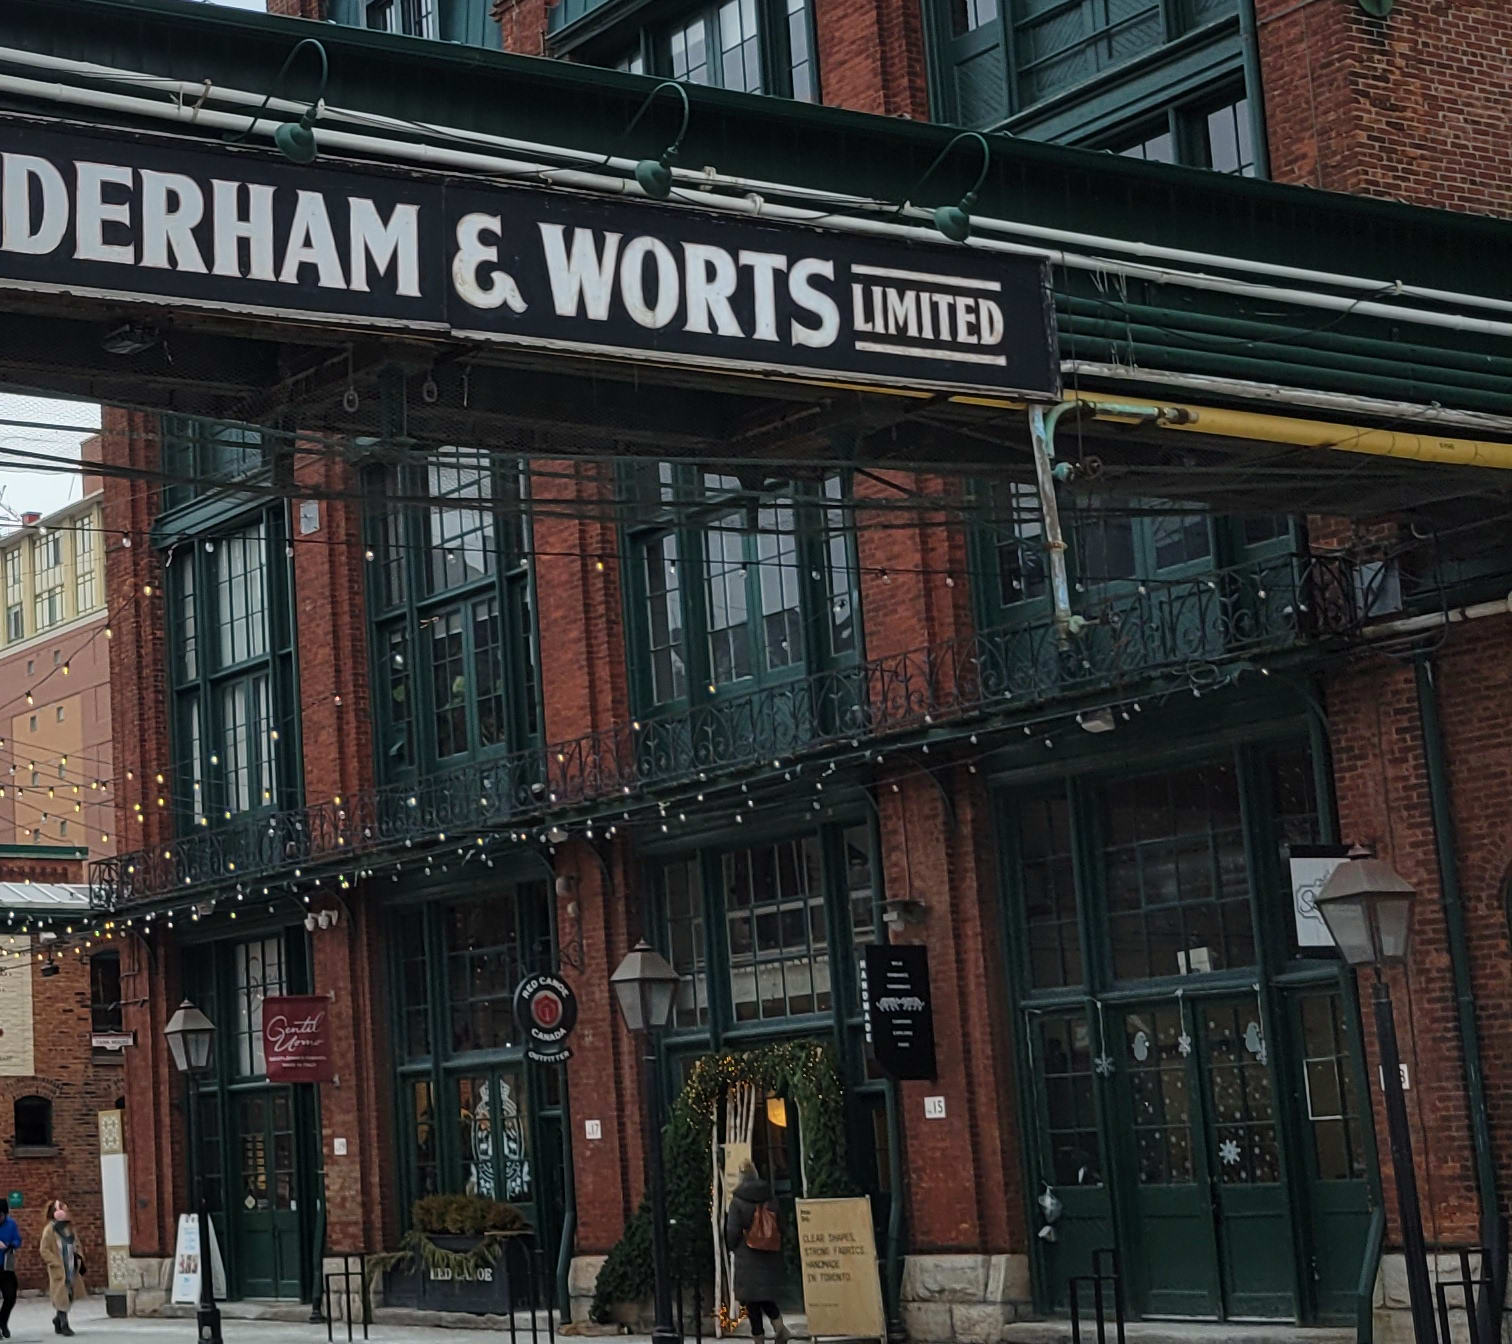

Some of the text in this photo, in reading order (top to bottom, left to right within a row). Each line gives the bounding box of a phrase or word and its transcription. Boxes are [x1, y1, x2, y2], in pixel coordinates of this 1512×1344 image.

[452, 212, 528, 314] &
[537, 222, 840, 348] WORTS
[851, 282, 1005, 346] LIMITED
[521, 976, 570, 1000] RED CANOE
[859, 959, 873, 1043] HANDMADE
[531, 1027, 568, 1042] CANADA
